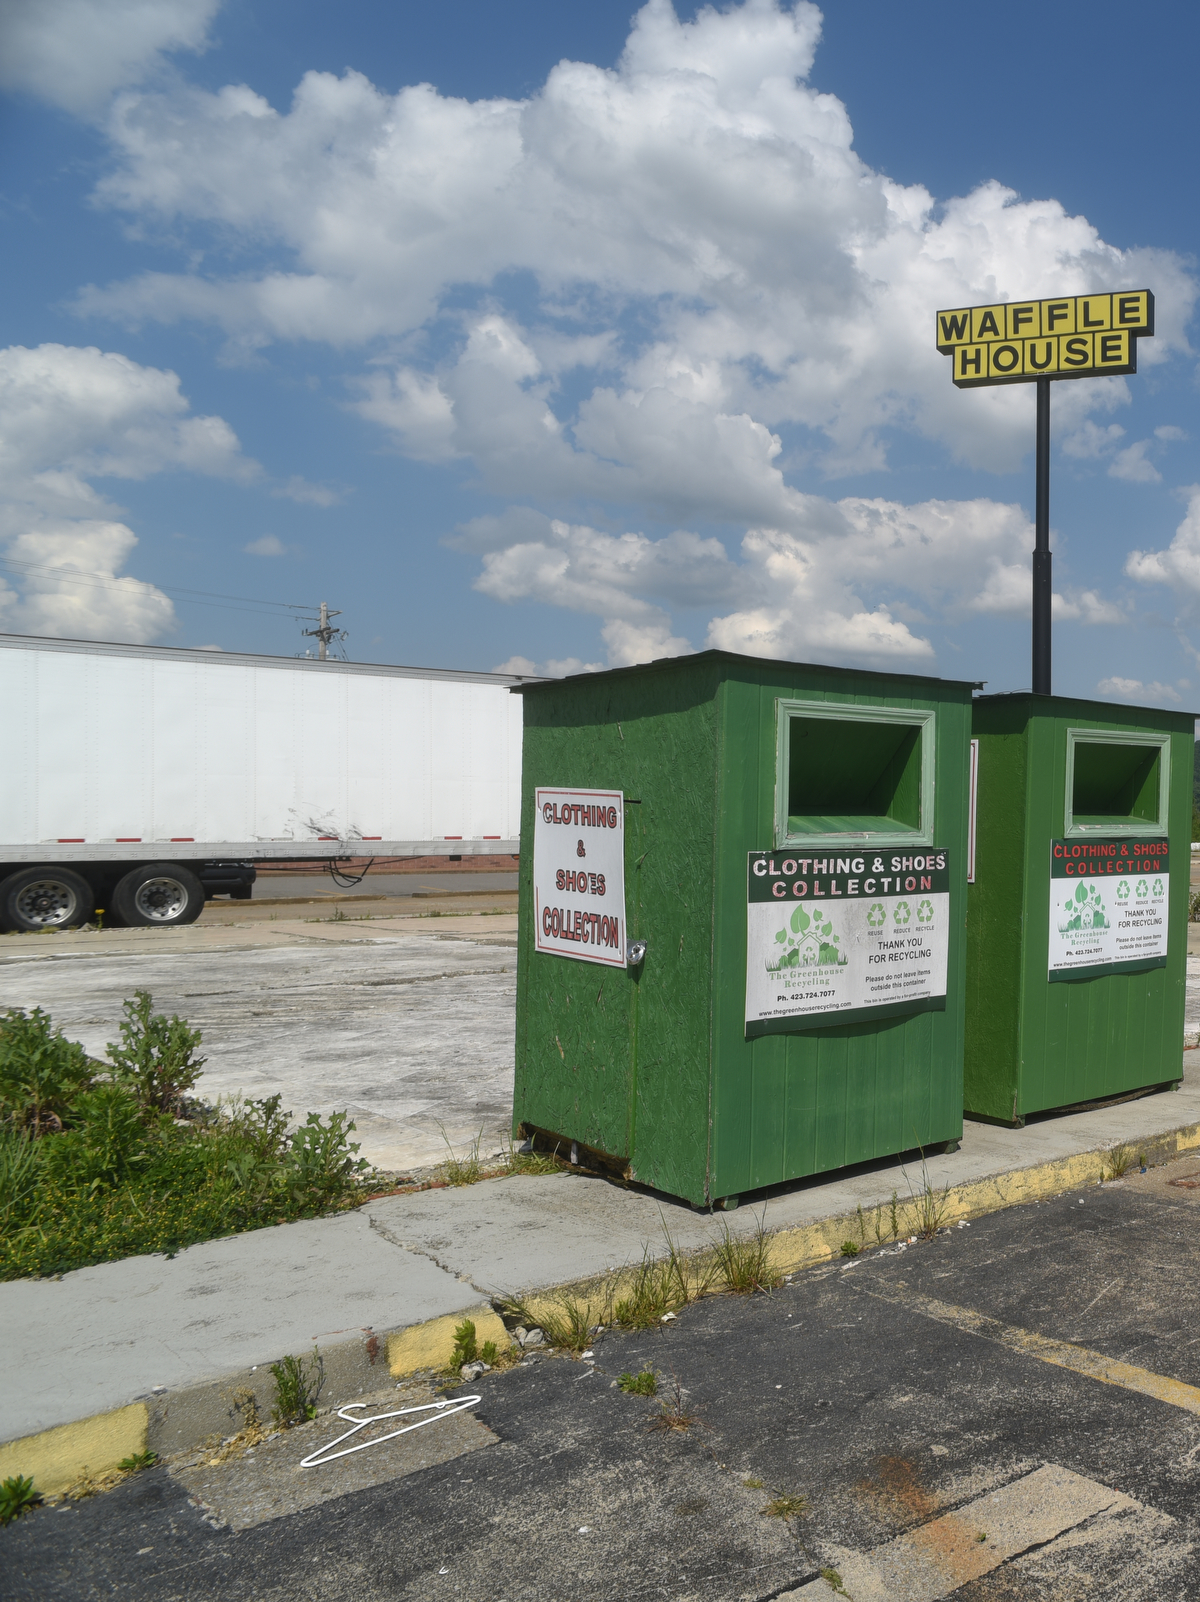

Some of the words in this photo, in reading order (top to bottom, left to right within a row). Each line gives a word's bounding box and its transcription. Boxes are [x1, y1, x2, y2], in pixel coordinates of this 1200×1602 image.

[940, 296, 1141, 341] WAFFLE
[961, 334, 1122, 376] HOUSE
[543, 802, 617, 828] CLOTHING
[577, 840, 586, 857] &
[1054, 844, 1116, 858] CLOTHING
[1120, 844, 1128, 856] &
[1133, 843, 1168, 856] SHOES
[753, 858, 865, 876] CLOTHING
[872, 857, 885, 873] &
[891, 855, 946, 872] SHOES
[1066, 860, 1160, 874] COLLECTION
[556, 869, 606, 896] SHOES
[772, 876, 932, 897] COLLECTION
[543, 906, 619, 949] COLLECTION
[1132, 918, 1162, 927] RECYCLING
[878, 940, 905, 950] THANK
[907, 938, 922, 947] YOU
[869, 954, 886, 964] FOR
[888, 949, 931, 962] RECYCLING
[769, 972, 787, 980] The
[790, 968, 844, 978] Greenhouse
[784, 978, 830, 988] Recycling
[871, 983, 891, 991] outside
[903, 979, 926, 987] container
[790, 990, 835, 1000] 423.724.7077
[759, 1002, 851, 1016] www.thegreenhouserecycling.com
